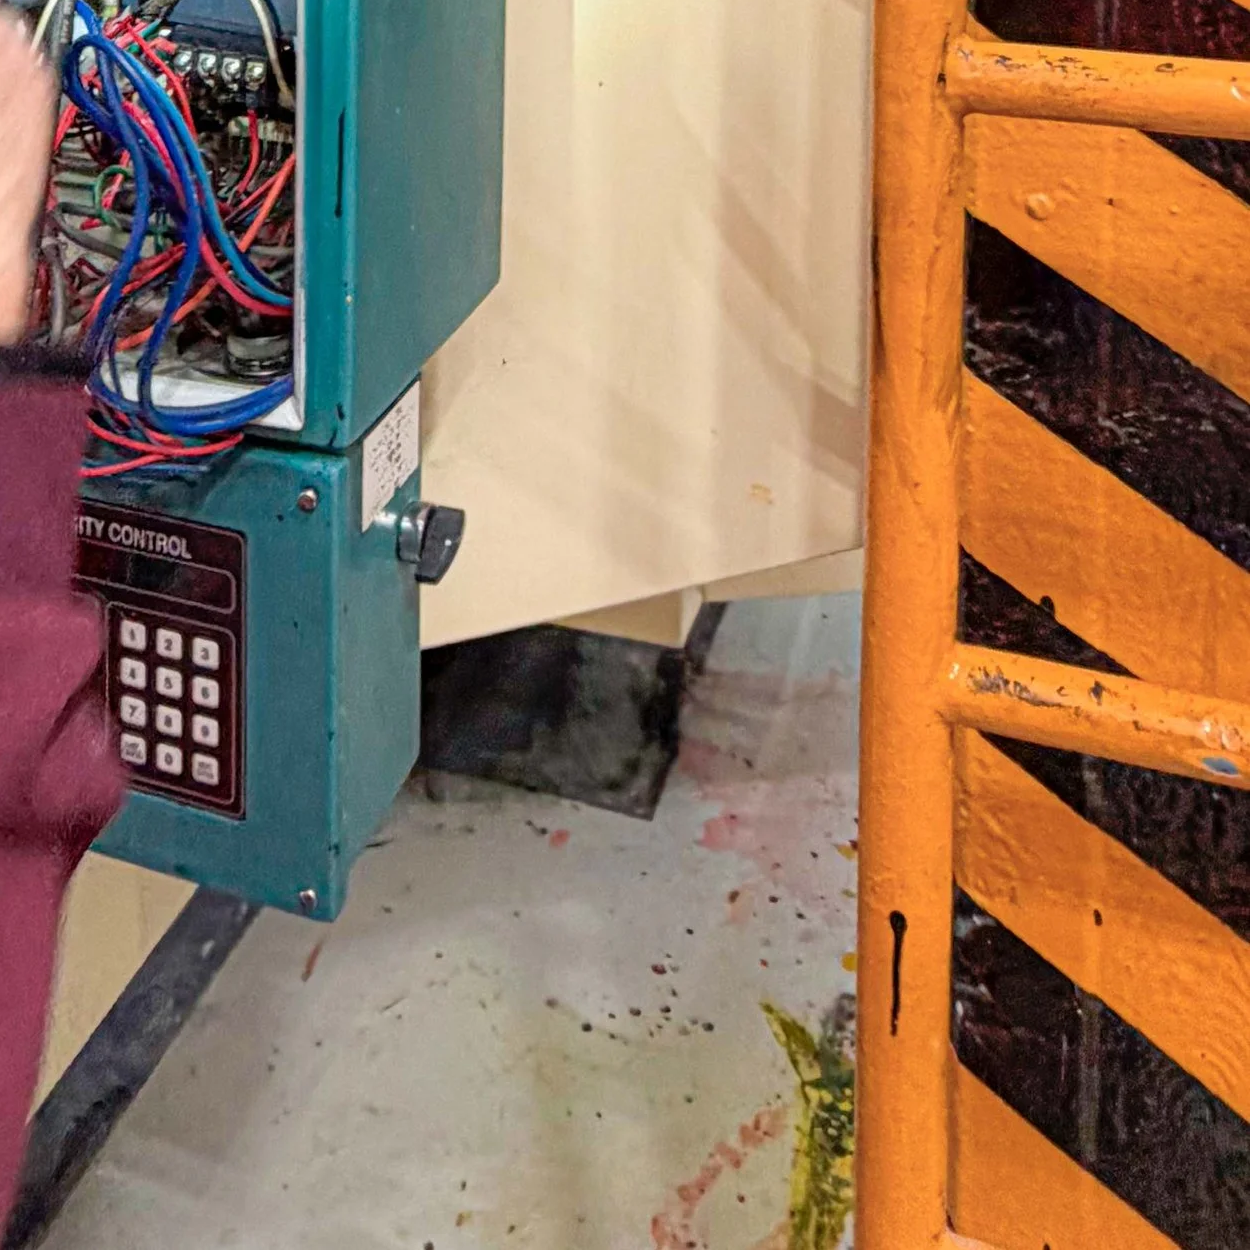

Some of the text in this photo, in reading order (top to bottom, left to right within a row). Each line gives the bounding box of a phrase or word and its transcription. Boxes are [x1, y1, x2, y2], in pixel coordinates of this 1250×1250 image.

[74, 516, 192, 560] ITY CONTROL
[163, 638, 173, 651] 2
[200, 648, 210, 661] 3
[128, 667, 211, 700] 4 5 6
[128, 704, 139, 718] 7
[164, 715, 173, 728] 8
[164, 752, 173, 765] 0
